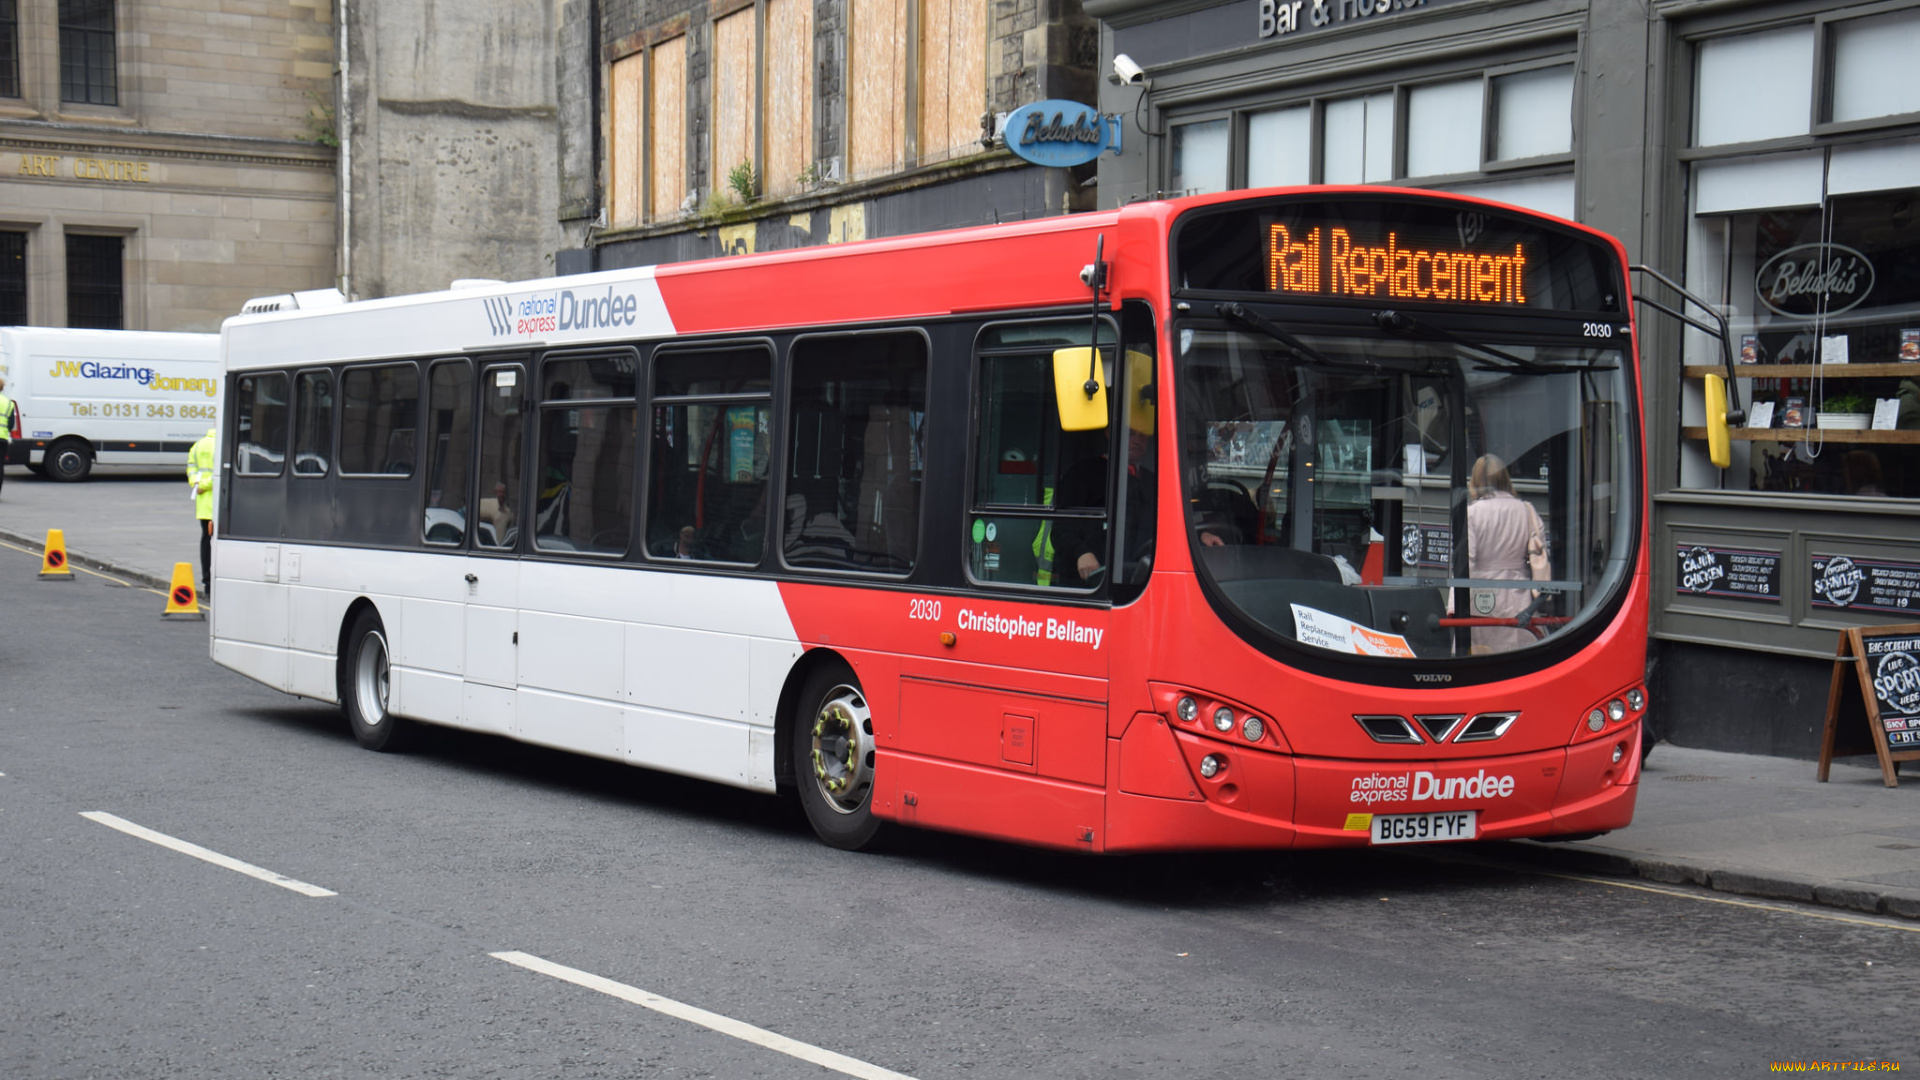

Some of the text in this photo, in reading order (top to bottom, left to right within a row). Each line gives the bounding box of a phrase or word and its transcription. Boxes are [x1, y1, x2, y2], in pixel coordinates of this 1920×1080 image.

[1259, 0, 1300, 38] Bar
[1020, 111, 1100, 145] Belushi's
[18, 154, 149, 182] ART CENTRE
[1270, 224, 1526, 303] Rail Replacement
[1770, 257, 1857, 300] Belushi's
[518, 286, 637, 331] national Dundee
[517, 316, 556, 339] express
[1583, 323, 1612, 338] 2030
[149, 373, 217, 397] Joinery
[70, 402, 216, 418] Tel: 0131 343 6642
[1683, 554, 1716, 572] CAJUN
[1683, 565, 1724, 587] CHICKEN
[1814, 569, 1867, 593] SCHNITZEL
[909, 598, 941, 621] 2030
[1298, 610, 1314, 621] Rail
[957, 609, 1103, 650] Christopher Bellany
[1301, 621, 1346, 643] Replacement
[1302, 632, 1329, 648] Service
[1368, 636, 1389, 646] RAIL
[1868, 642, 1884, 653] BIG
[1888, 659, 1904, 671] LIVE
[1413, 674, 1452, 682] VOLVO
[1886, 720, 1905, 729] SKY
[1902, 731, 1915, 742] BT
[1352, 769, 1515, 801] national Dundee
[1350, 787, 1407, 806] express
[1381, 817, 1428, 840] BG59
[1434, 815, 1467, 836] FYF
